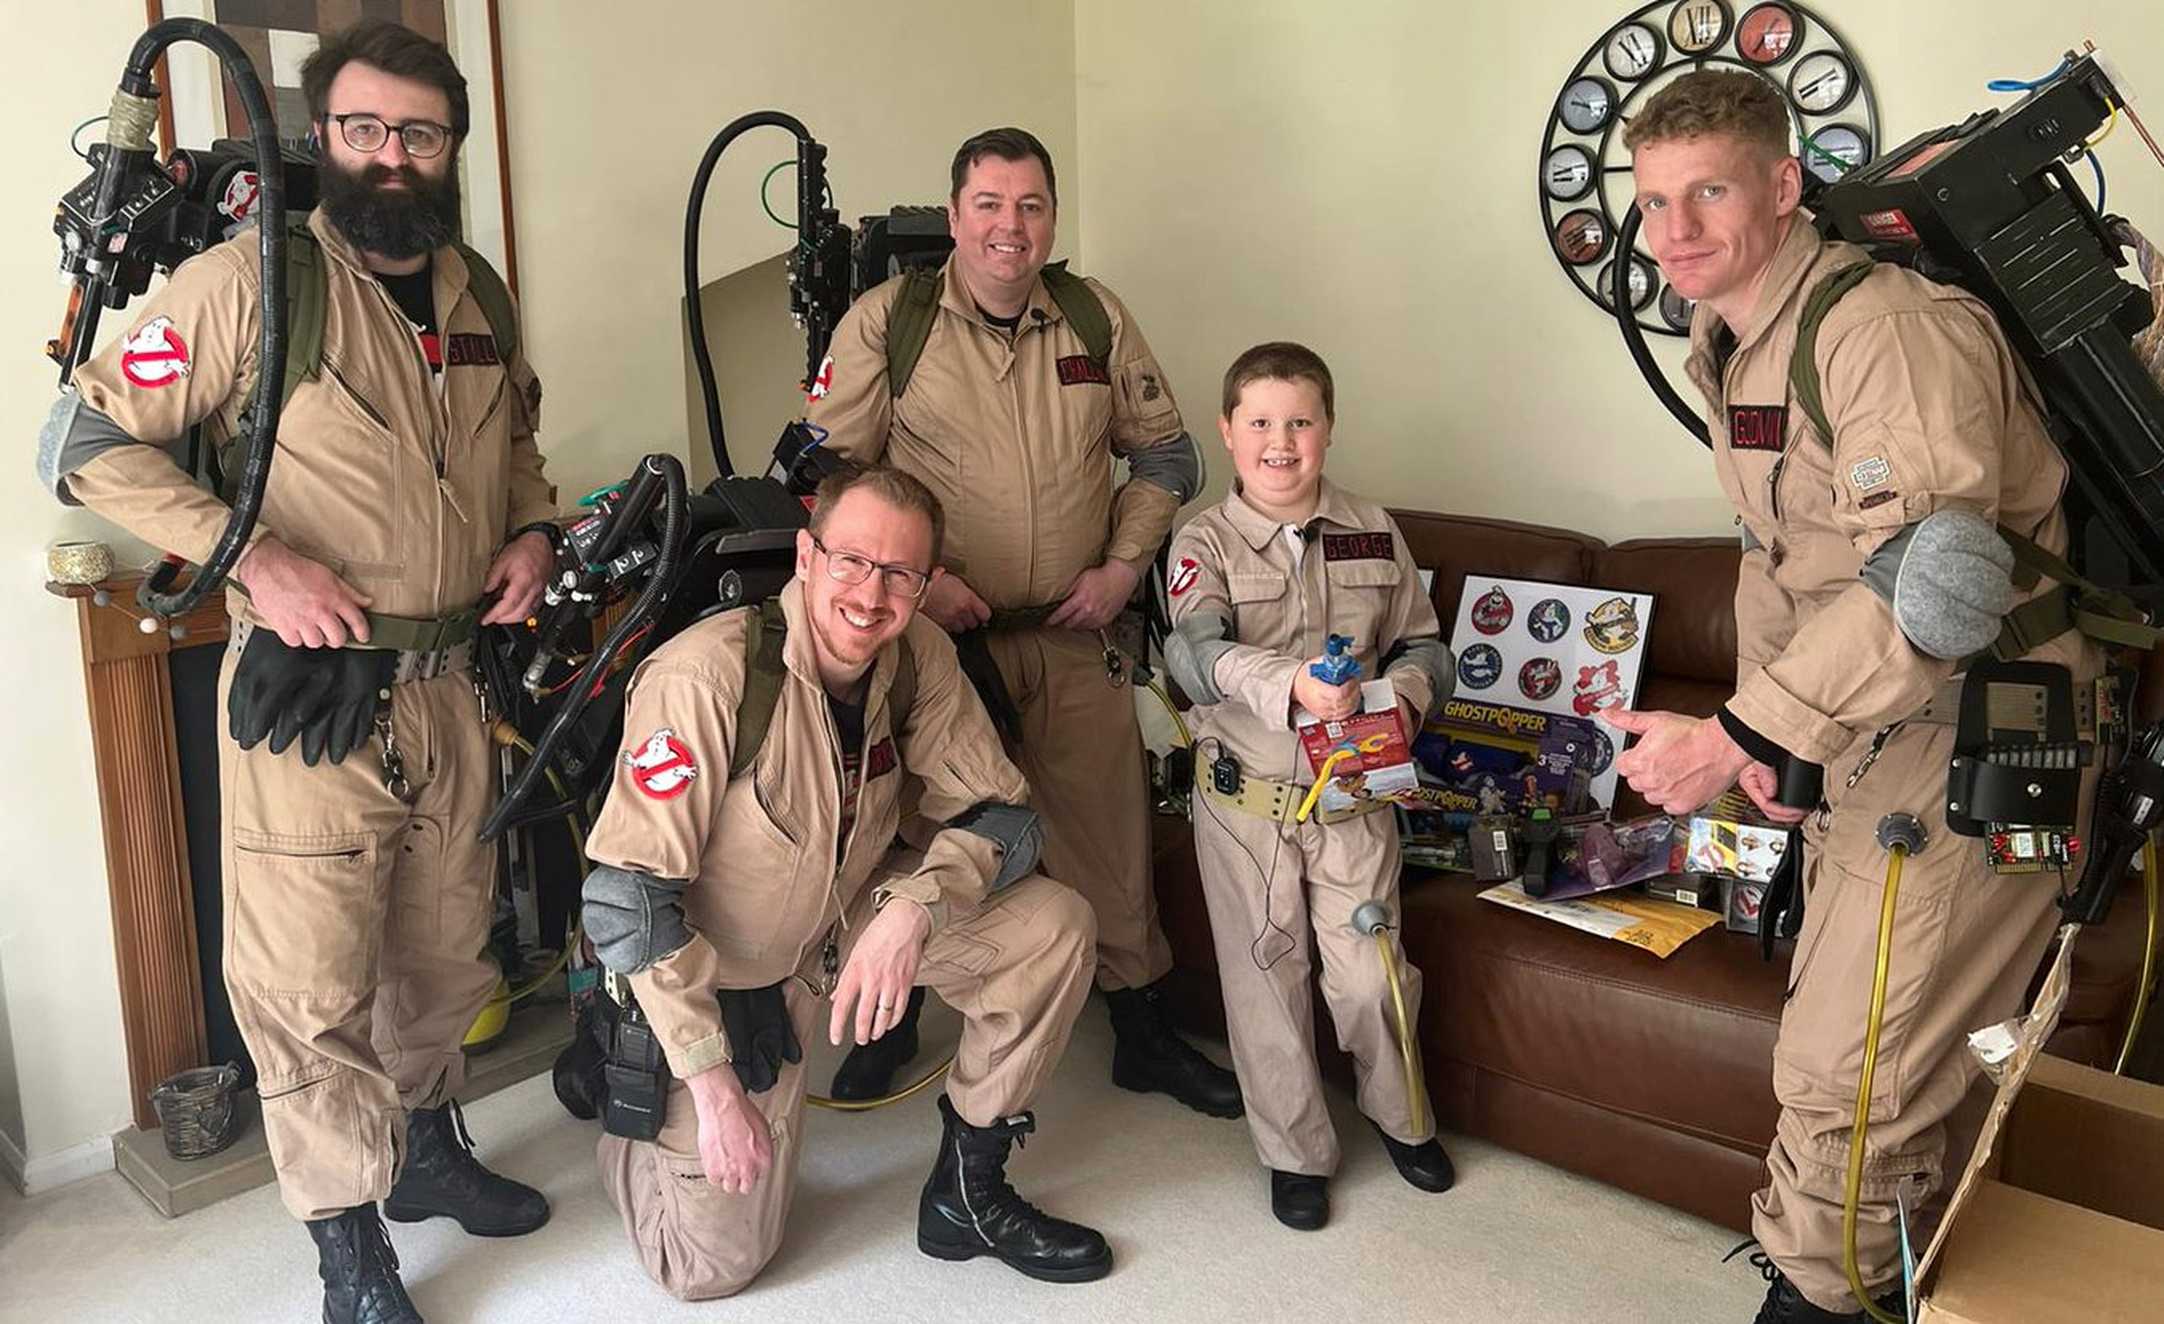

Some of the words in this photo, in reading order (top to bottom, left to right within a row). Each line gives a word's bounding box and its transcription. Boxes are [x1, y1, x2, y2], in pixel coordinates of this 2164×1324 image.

[1325, 535, 1393, 559] GEORGE
[1444, 700, 1547, 736] GHOSTPOPPER
[1537, 754, 1548, 767] 3
